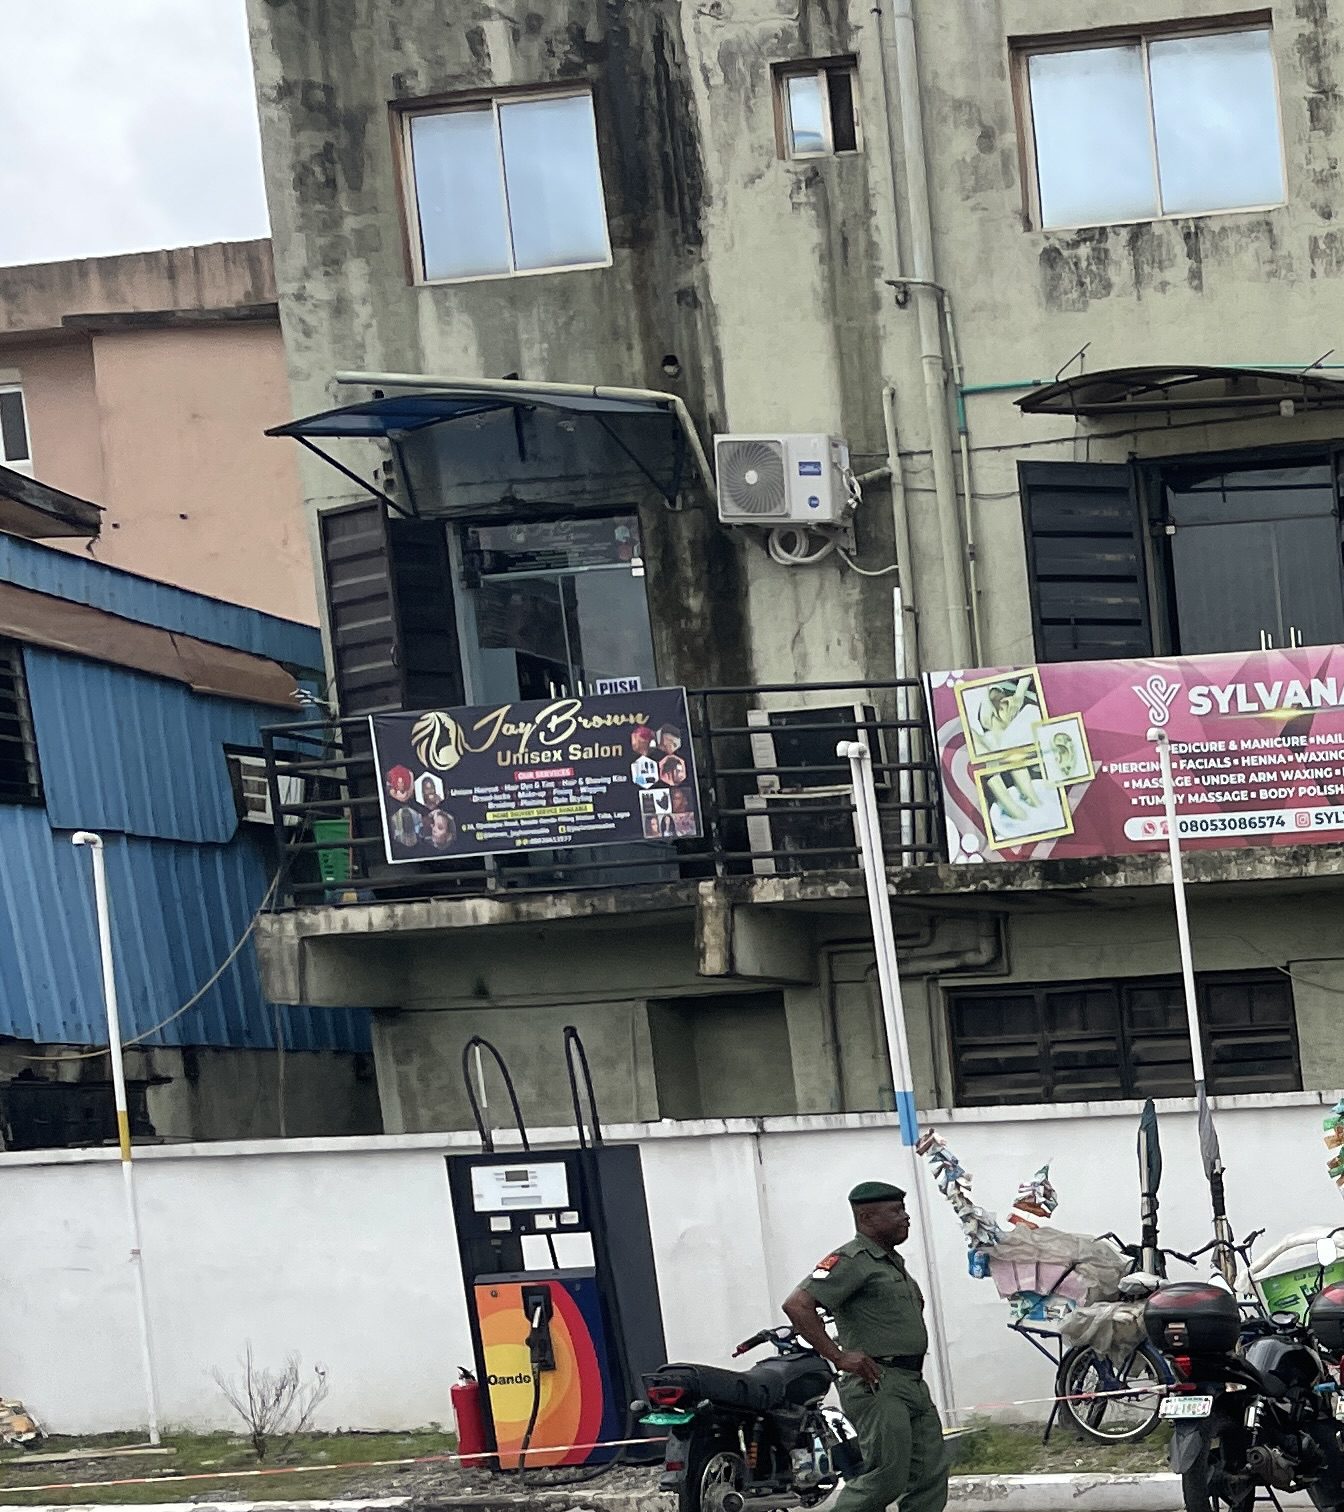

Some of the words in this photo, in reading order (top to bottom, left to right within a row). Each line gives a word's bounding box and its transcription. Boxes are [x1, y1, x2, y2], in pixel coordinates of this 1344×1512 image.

[600, 680, 639, 695] PUSH
[1228, 740, 1238, 751] &
[1240, 735, 1308, 750] MANICURE
[497, 748, 563, 767] Unisex
[568, 742, 623, 761] Salon
[1110, 761, 1164, 774] PIERCIN
[1179, 757, 1232, 770] FACIALS
[1241, 754, 1287, 767] HENNA
[1201, 773, 1246, 786] UNDER
[1249, 771, 1277, 784] ARM
[1281, 767, 1333, 781] WAXING
[1188, 790, 1248, 804] MASSAGE
[1259, 786, 1295, 799] BODY
[1298, 784, 1344, 797] POLISH
[1179, 815, 1286, 833] 08053086574
[488, 1373, 531, 1386] Oando
